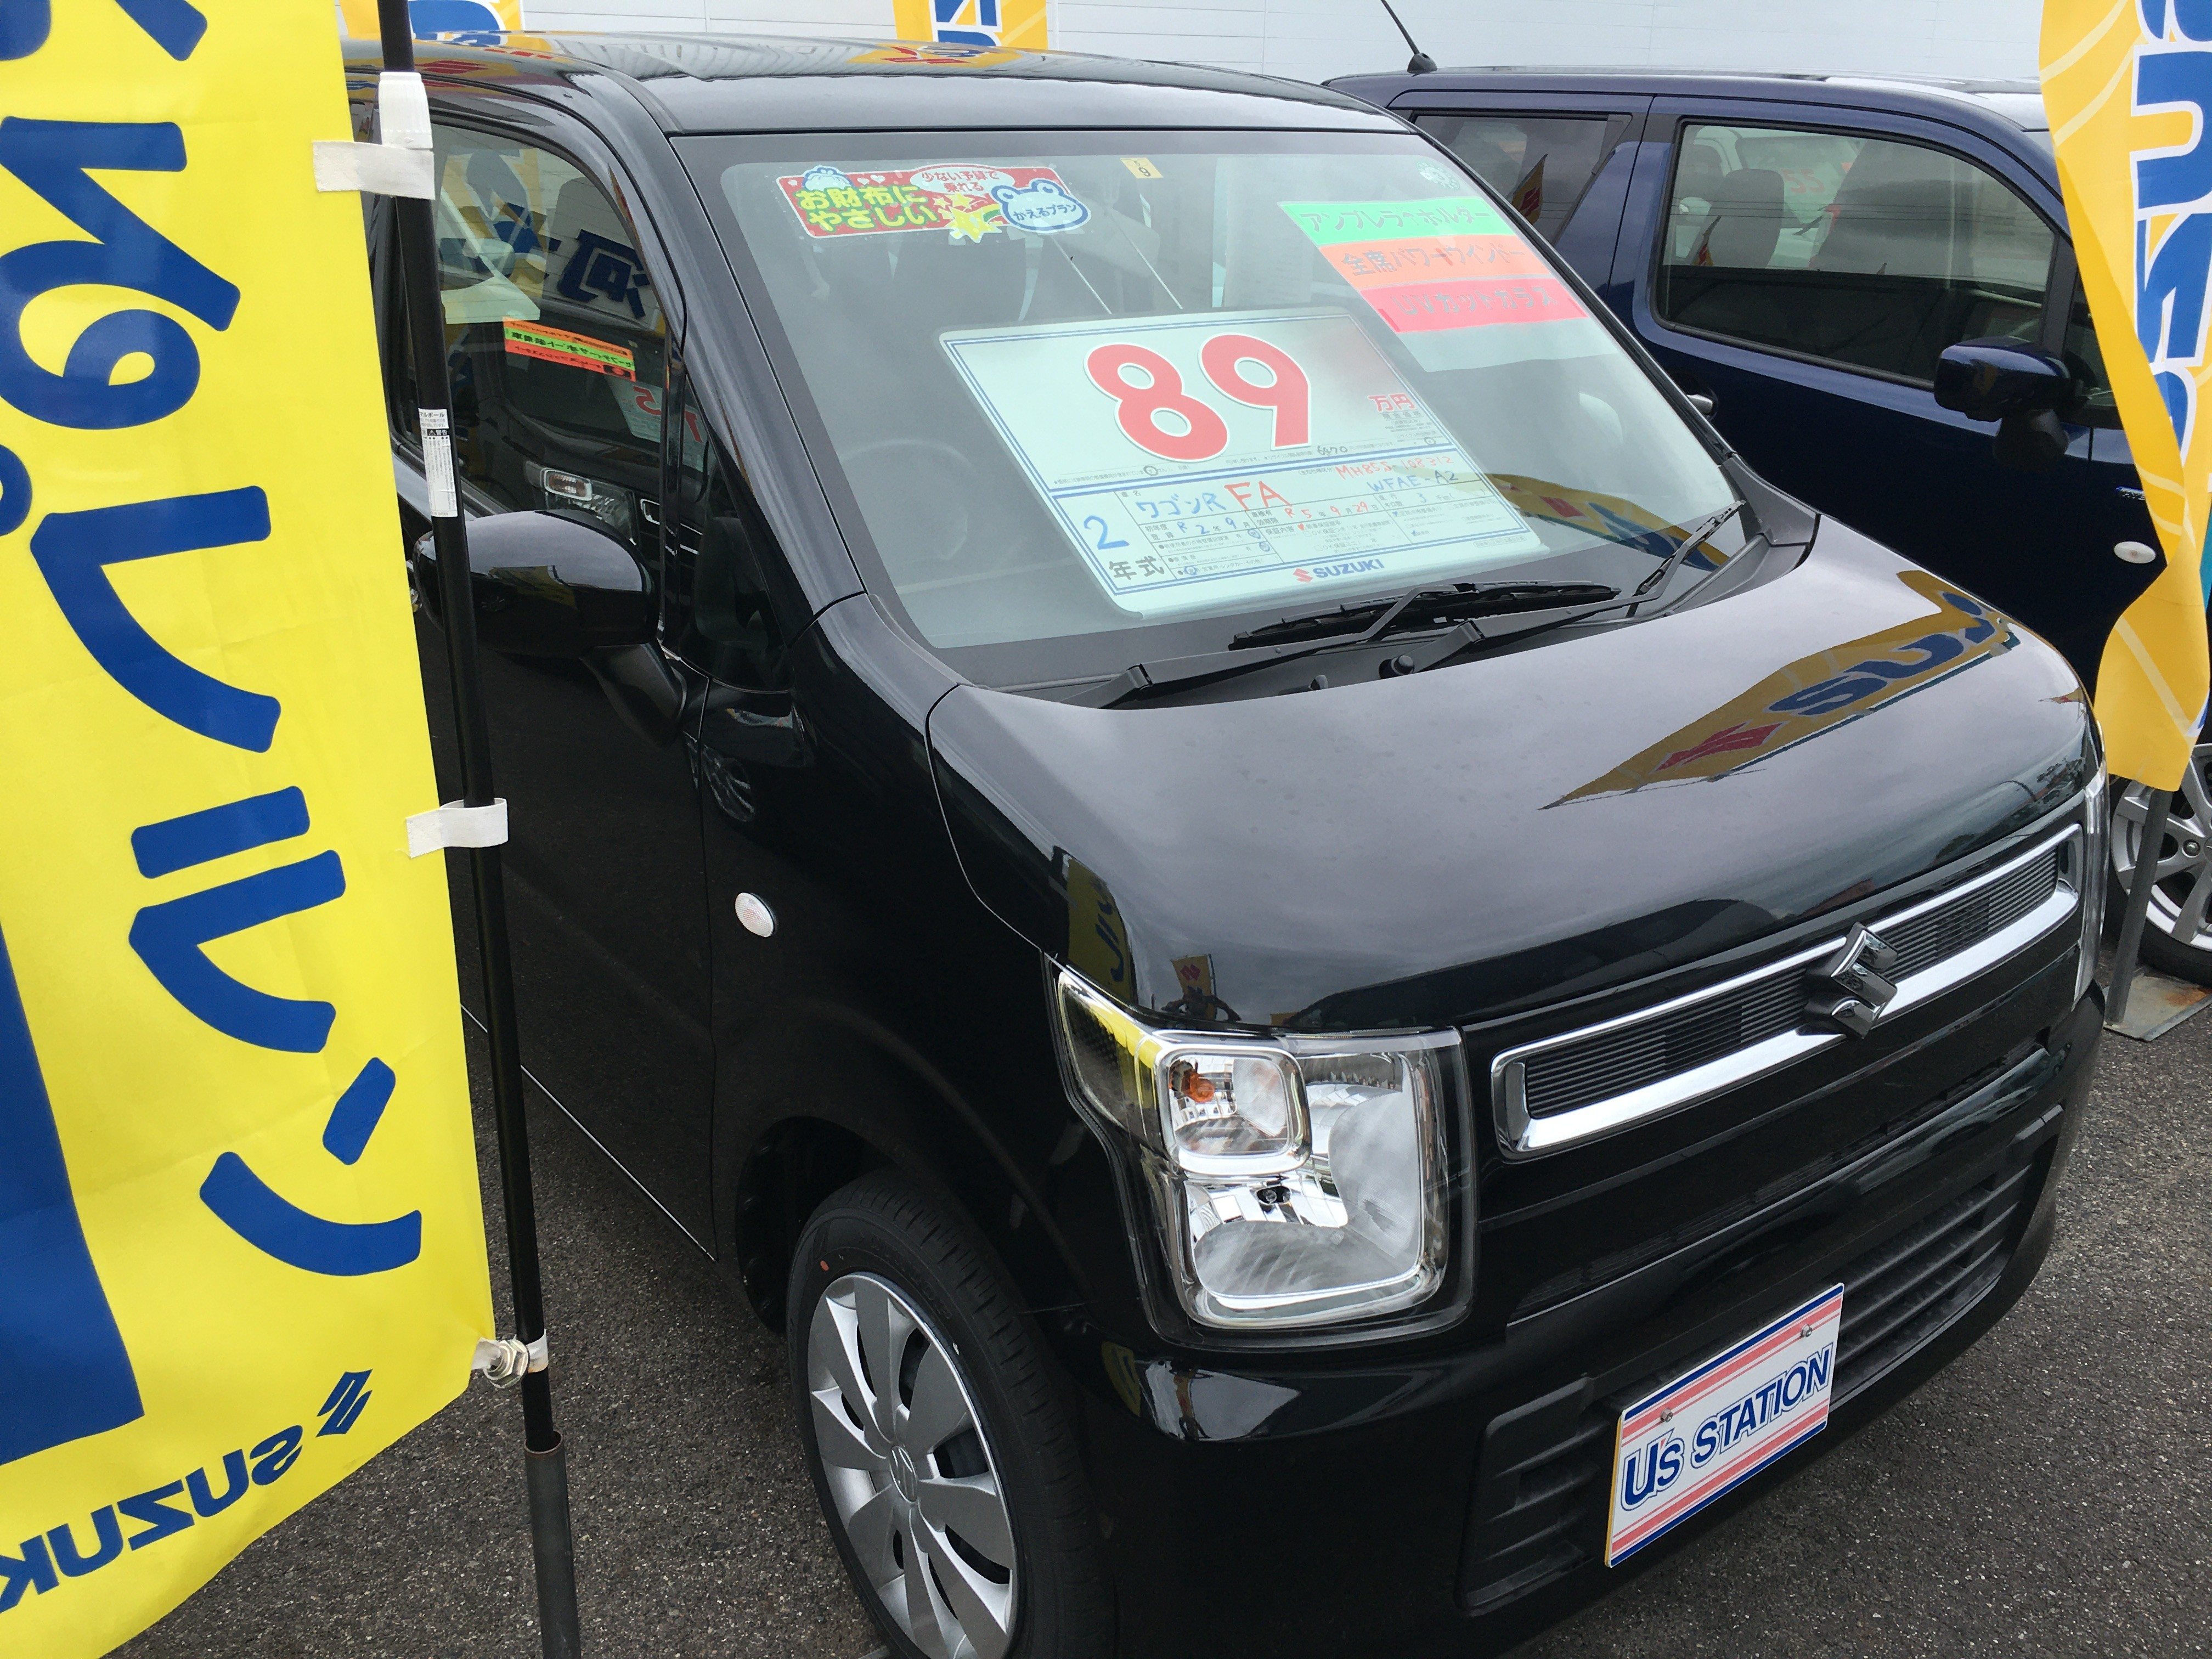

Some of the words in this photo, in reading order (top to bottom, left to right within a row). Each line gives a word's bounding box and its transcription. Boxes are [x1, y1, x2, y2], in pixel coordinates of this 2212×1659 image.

[922, 171, 1000, 182] 少ない予算で
[944, 182, 984, 192] 乗れる
[795, 185, 928, 210] お財布に
[809, 206, 937, 232] やさしい
[1393, 286, 1559, 317] UVカットガラス
[1084, 334, 1312, 461] 89
[1367, 393, 1416, 412] 万円
[1224, 481, 1293, 511] FA
[1084, 515, 1130, 550] 2
[1108, 556, 1165, 582] 年式
[1313, 558, 1385, 578] SUZUKI
[1692, 1345, 1832, 1467] STATION
